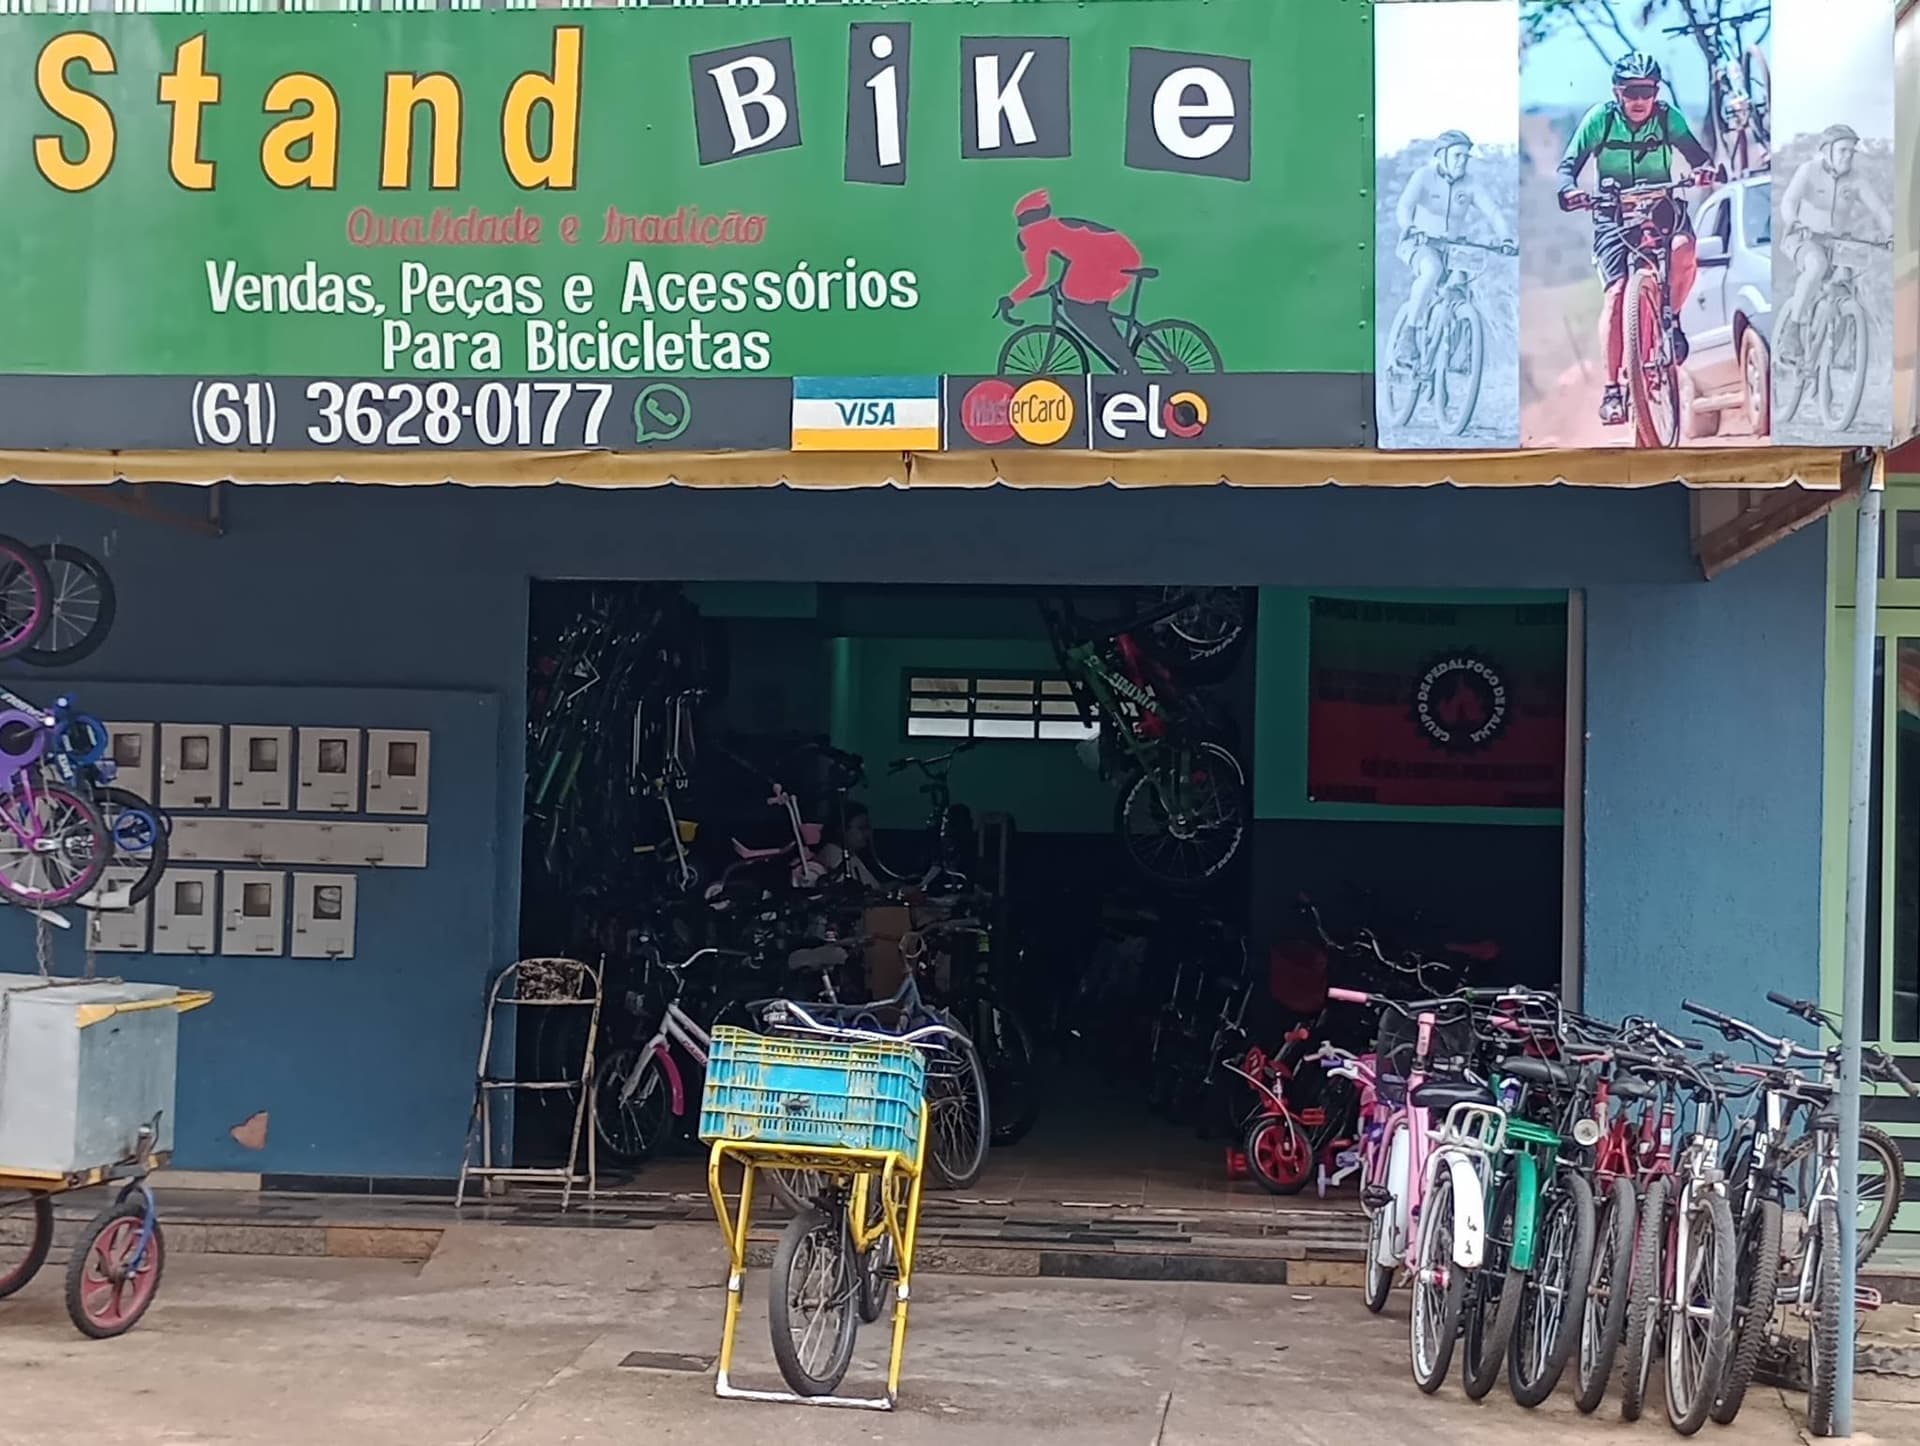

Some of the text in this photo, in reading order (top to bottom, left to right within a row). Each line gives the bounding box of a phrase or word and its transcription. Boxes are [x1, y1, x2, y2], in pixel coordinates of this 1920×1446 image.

[33, 26, 583, 191] Stand
[348, 208, 541, 245] Qualidade
[560, 216, 581, 244] e
[205, 258, 919, 321] Vendas, Peças e Acessórios
[382, 319, 771, 373] Para Bicicletas
[191, 381, 613, 446] (61) 3628-0177
[836, 401, 896, 427] VISA
[1101, 384, 1210, 438] elo
[1424, 658, 1465, 684] PEDAL
